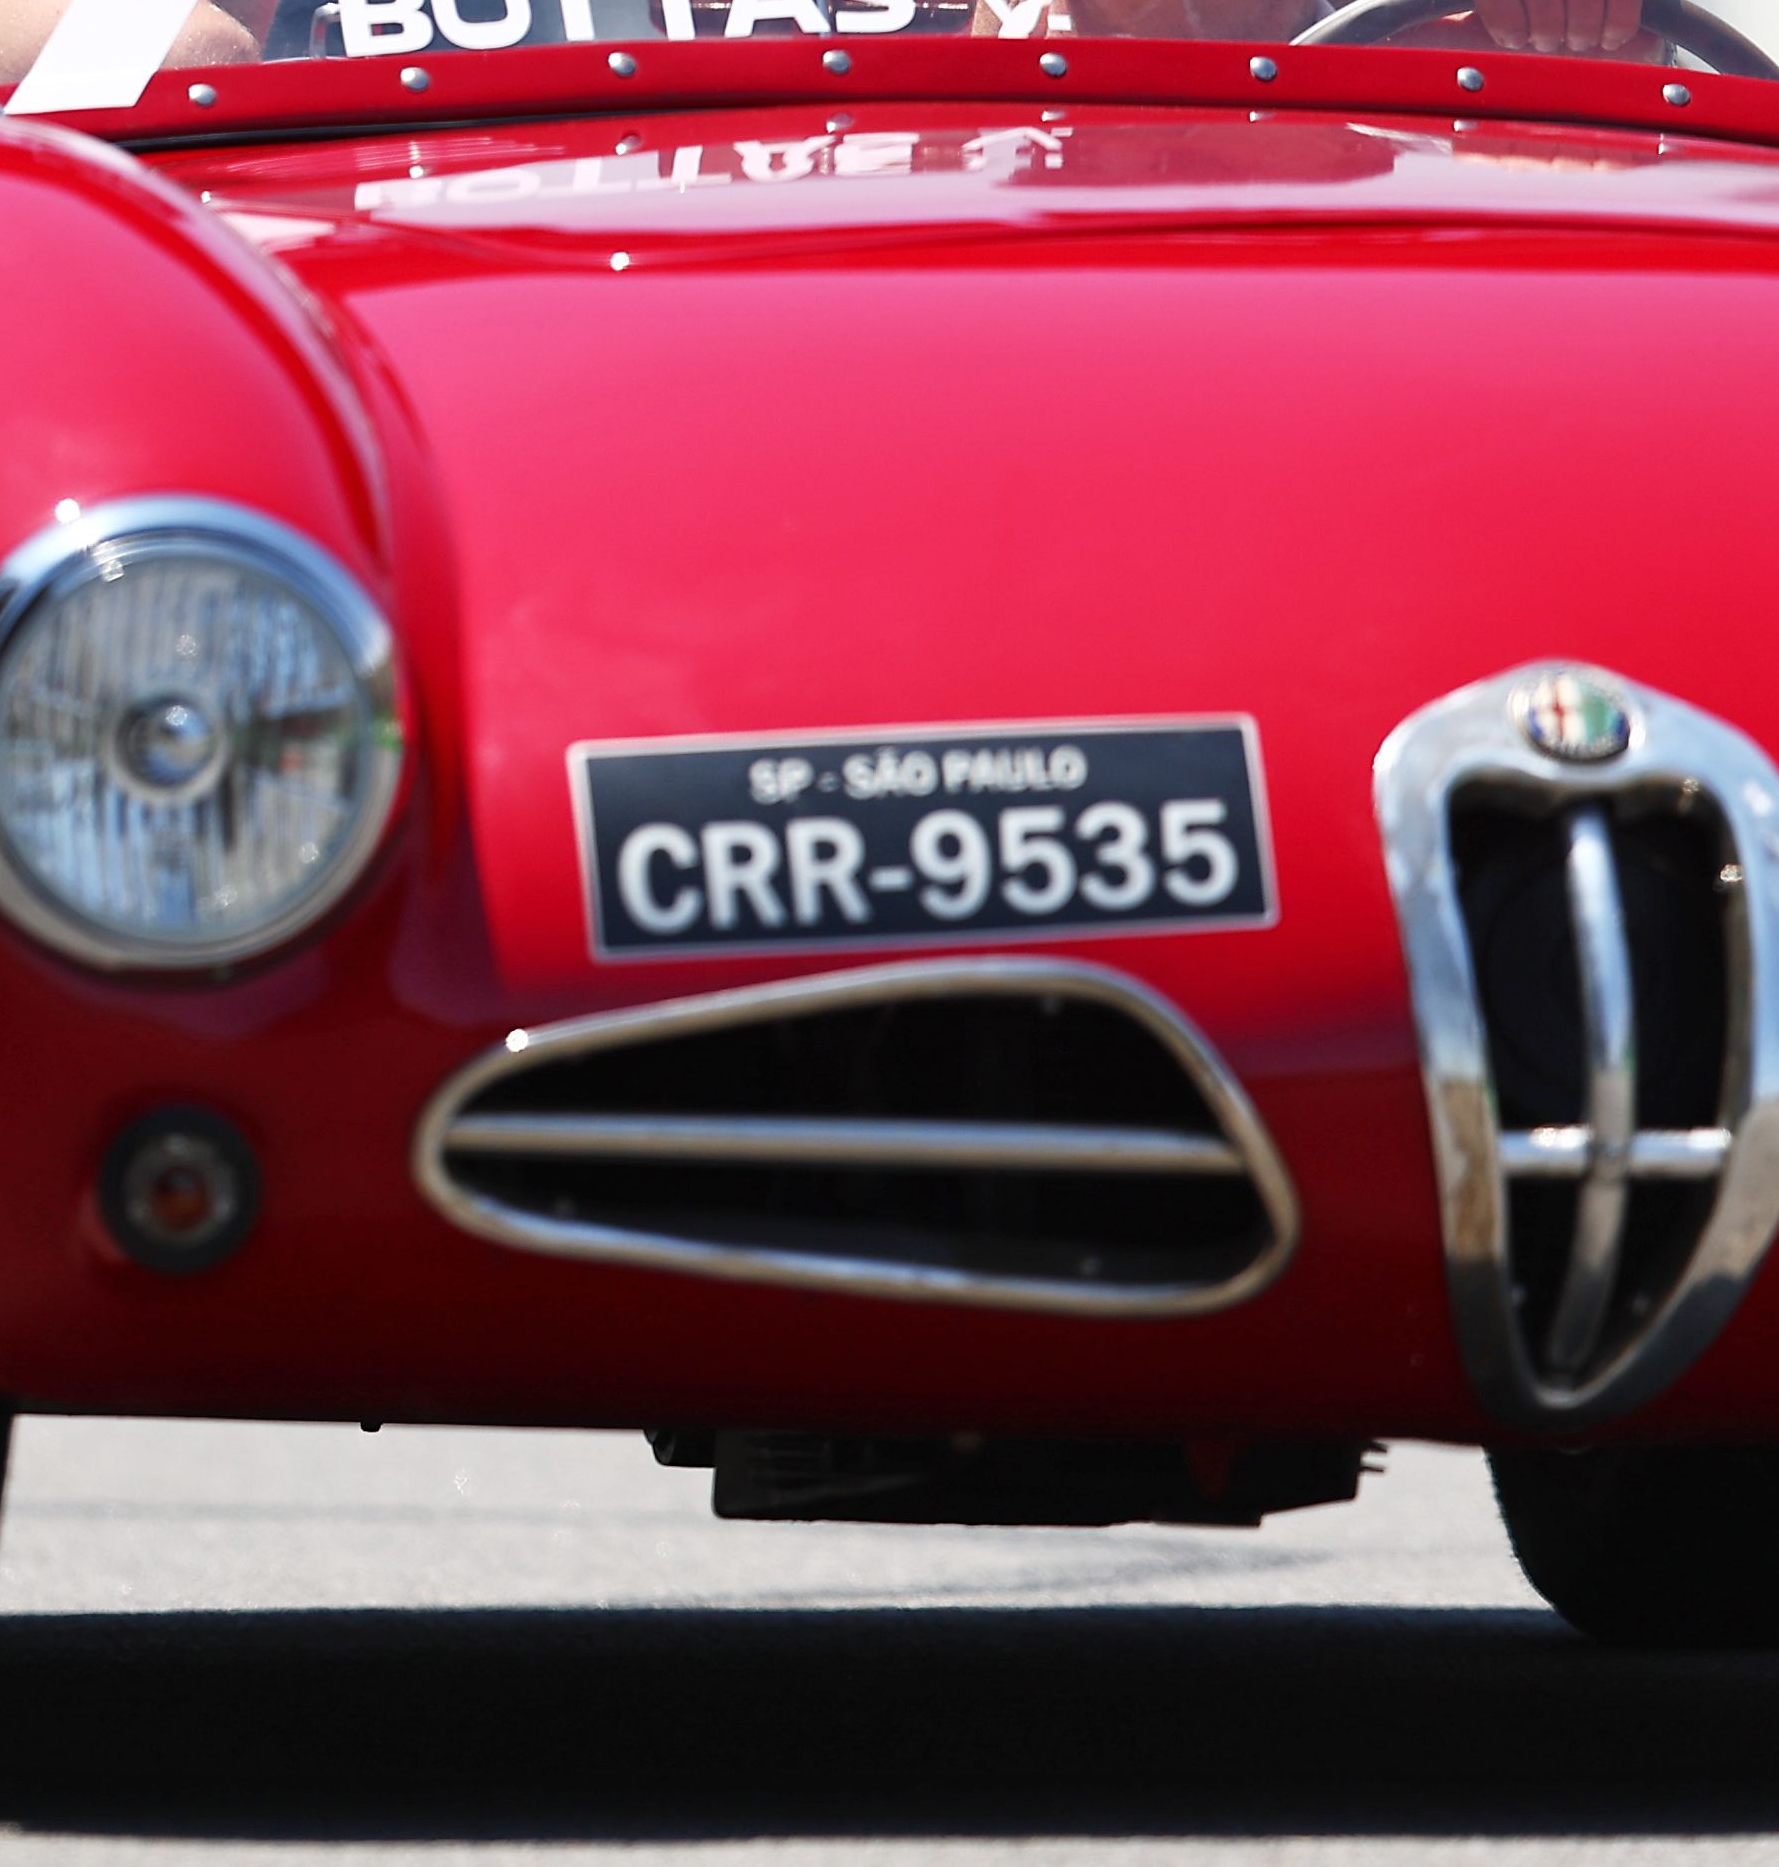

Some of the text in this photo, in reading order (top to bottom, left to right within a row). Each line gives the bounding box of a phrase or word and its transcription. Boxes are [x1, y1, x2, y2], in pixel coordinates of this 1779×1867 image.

[748, 757, 814, 805] SP
[842, 745, 939, 801] SÃO
[942, 743, 1089, 794] PAULO
[617, 798, 1239, 934] CRR-9535
